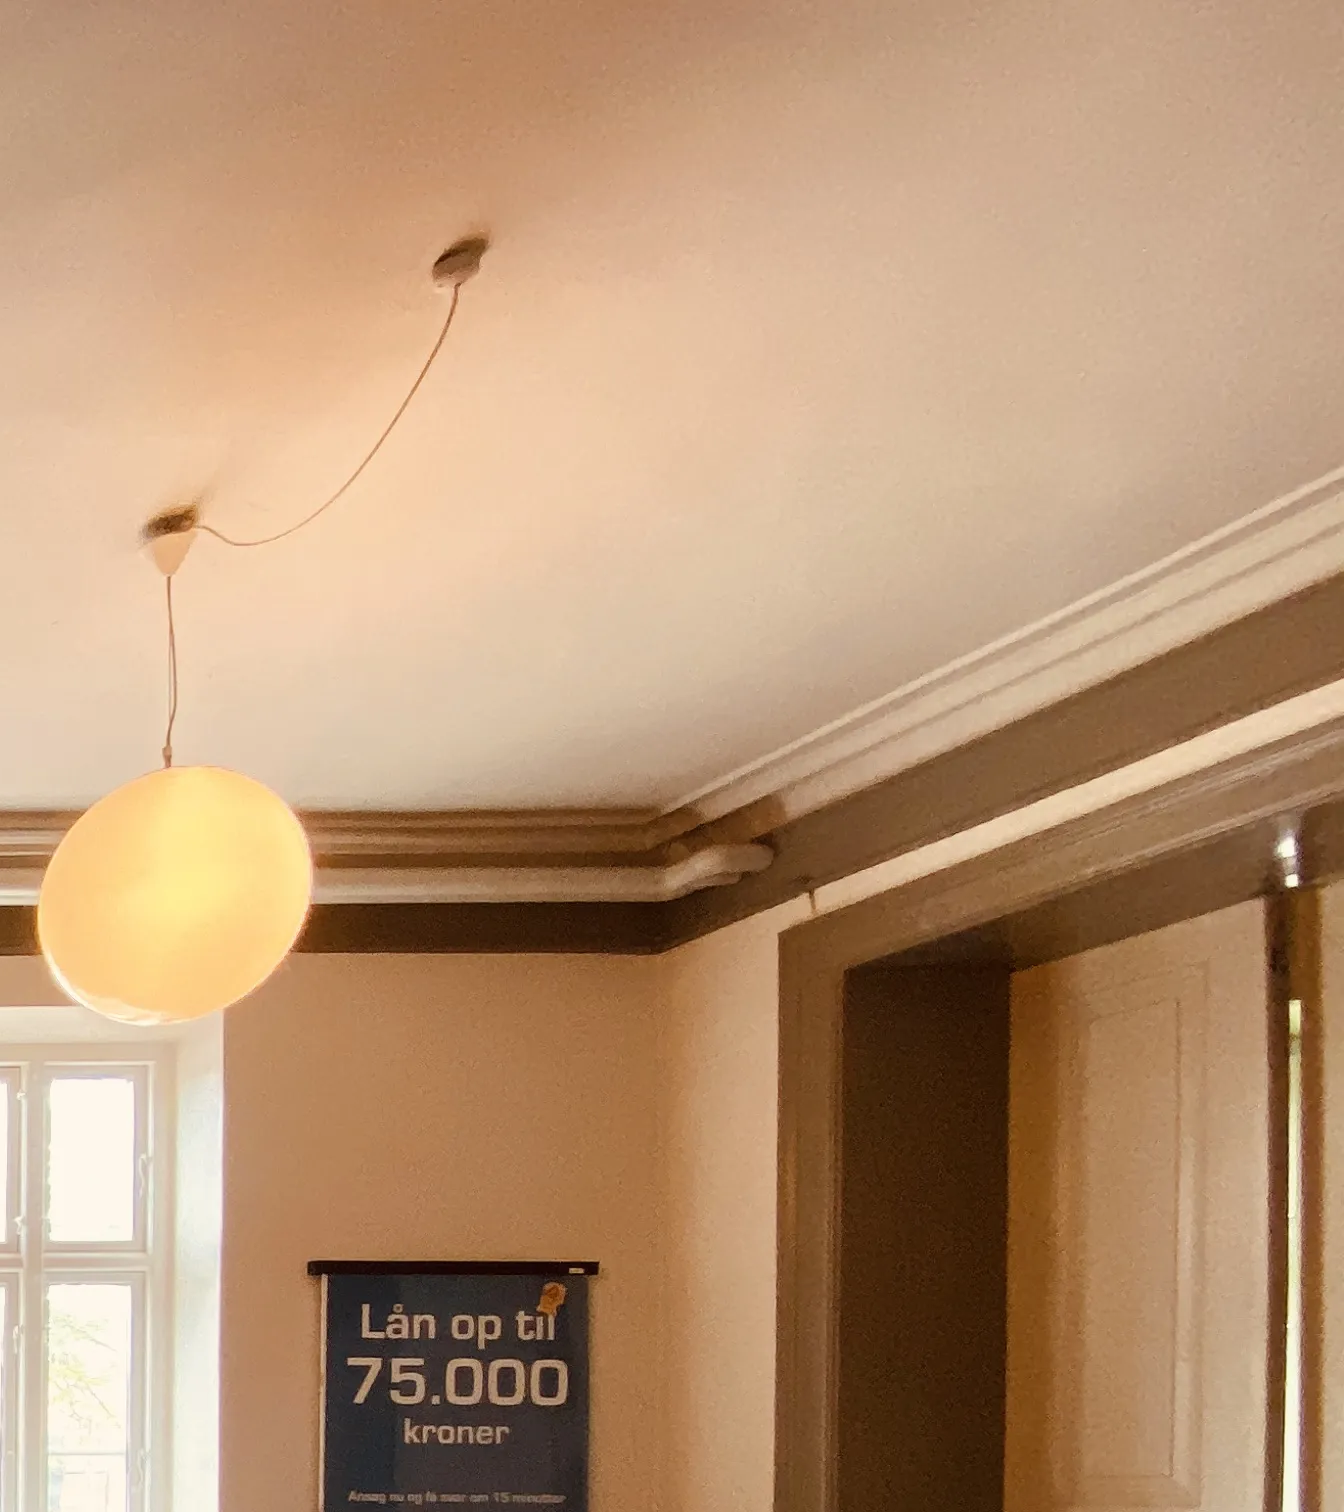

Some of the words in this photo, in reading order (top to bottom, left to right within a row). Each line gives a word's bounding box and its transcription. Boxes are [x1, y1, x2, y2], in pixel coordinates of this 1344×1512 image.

[362, 1302, 437, 1340] Lån
[451, 1313, 502, 1350] op
[515, 1307, 556, 1341] til
[347, 1356, 569, 1406] 75.000
[403, 1417, 511, 1446] kroner
